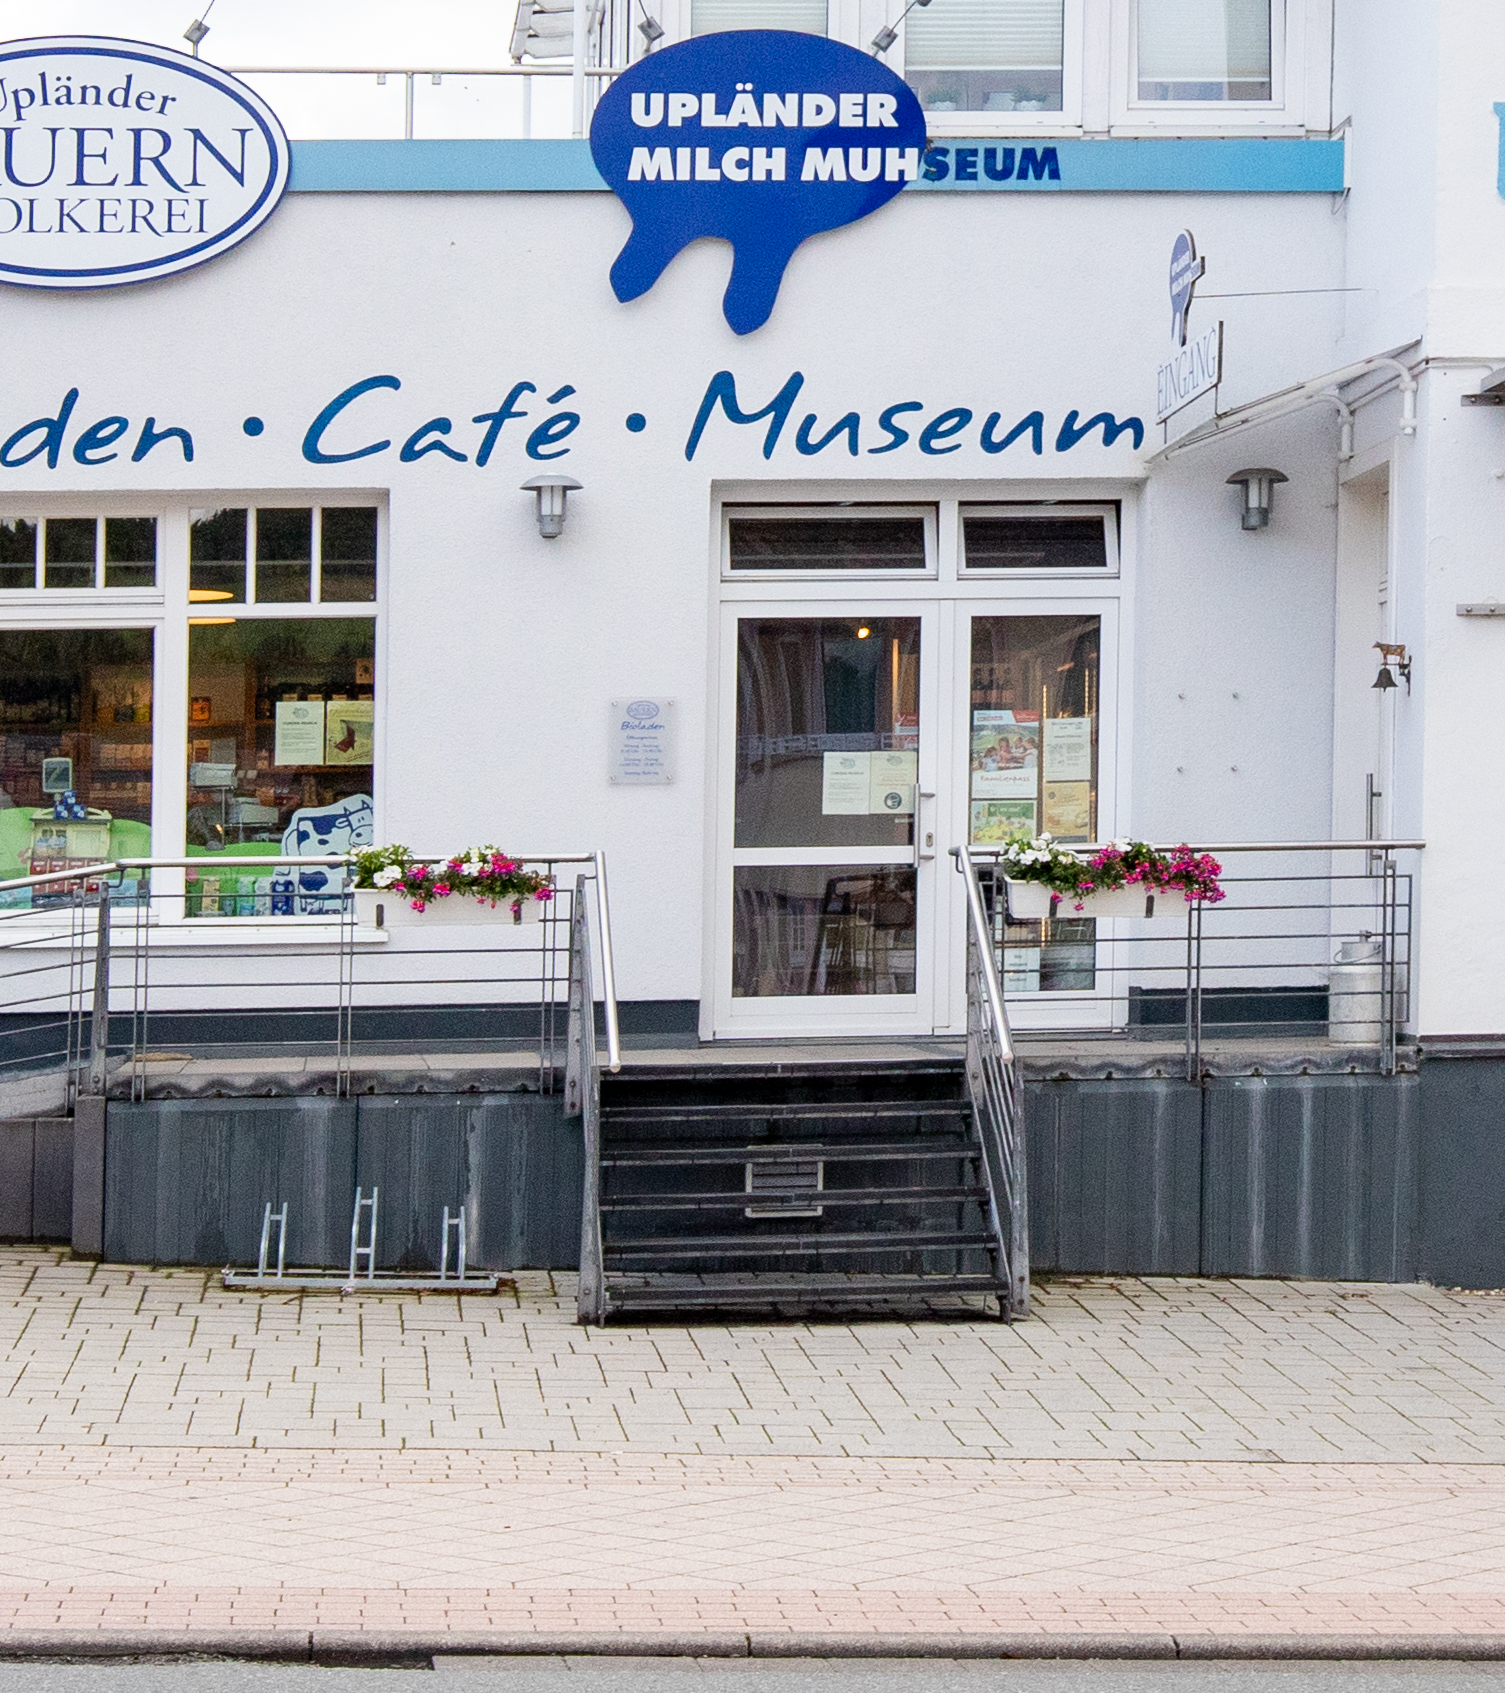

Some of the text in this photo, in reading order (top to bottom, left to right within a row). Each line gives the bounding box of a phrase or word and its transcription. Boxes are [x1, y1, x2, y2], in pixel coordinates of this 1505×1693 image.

[630, 83, 899, 128] UPLÄNDER
[627, 146, 1061, 182] MILCH MUHSEUM
[1157, 328, 1216, 416] EINGANG
[302, 374, 581, 468] Café
[685, 370, 1145, 462] Museum
[620, 721, 666, 730] Bioladen
